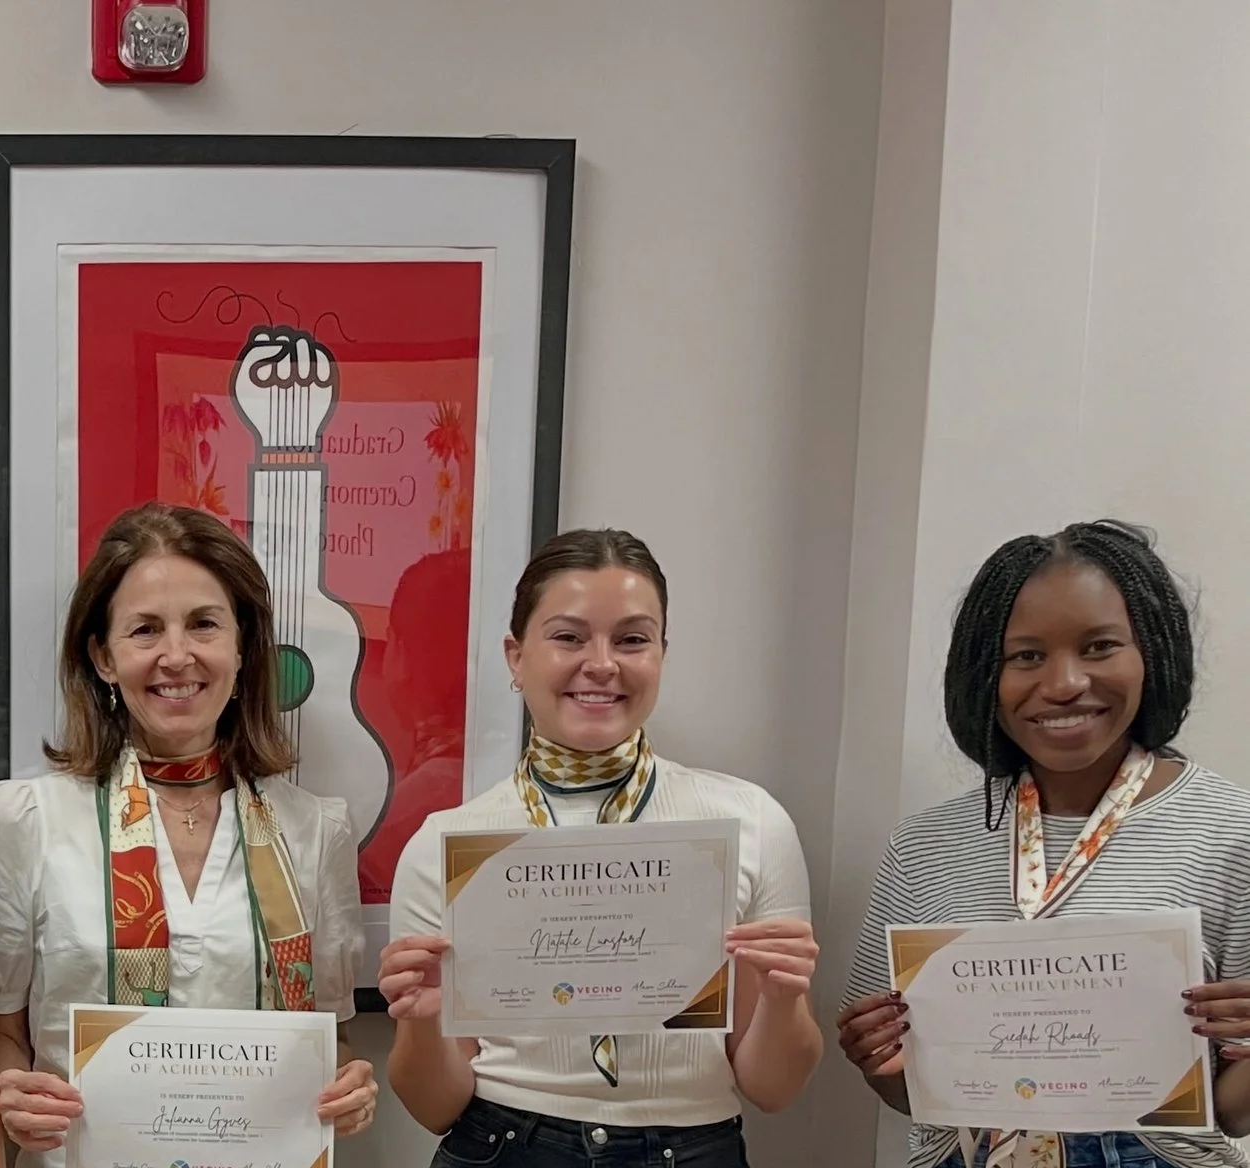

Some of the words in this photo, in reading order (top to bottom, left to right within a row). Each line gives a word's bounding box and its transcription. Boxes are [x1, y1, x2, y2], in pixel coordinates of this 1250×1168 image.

[505, 859, 671, 883] CERTIFICATE
[507, 887, 529, 899] OF
[539, 882, 668, 898] ACHIEVEMENT
[530, 928, 582, 958] Natalie
[586, 926, 646, 956] Lunsford
[952, 952, 1128, 978] CERTIFICATE
[577, 985, 623, 994] VECINO
[956, 982, 979, 994] OF
[989, 976, 1125, 993] ACHIEVEMENT
[128, 1041, 277, 1062] CERTIFICATE
[130, 1063, 151, 1074] OF
[159, 1064, 275, 1077] ACHIEVEMENT
[1039, 1082, 1088, 1090] VECINO
[153, 1105, 204, 1134] Julianna
